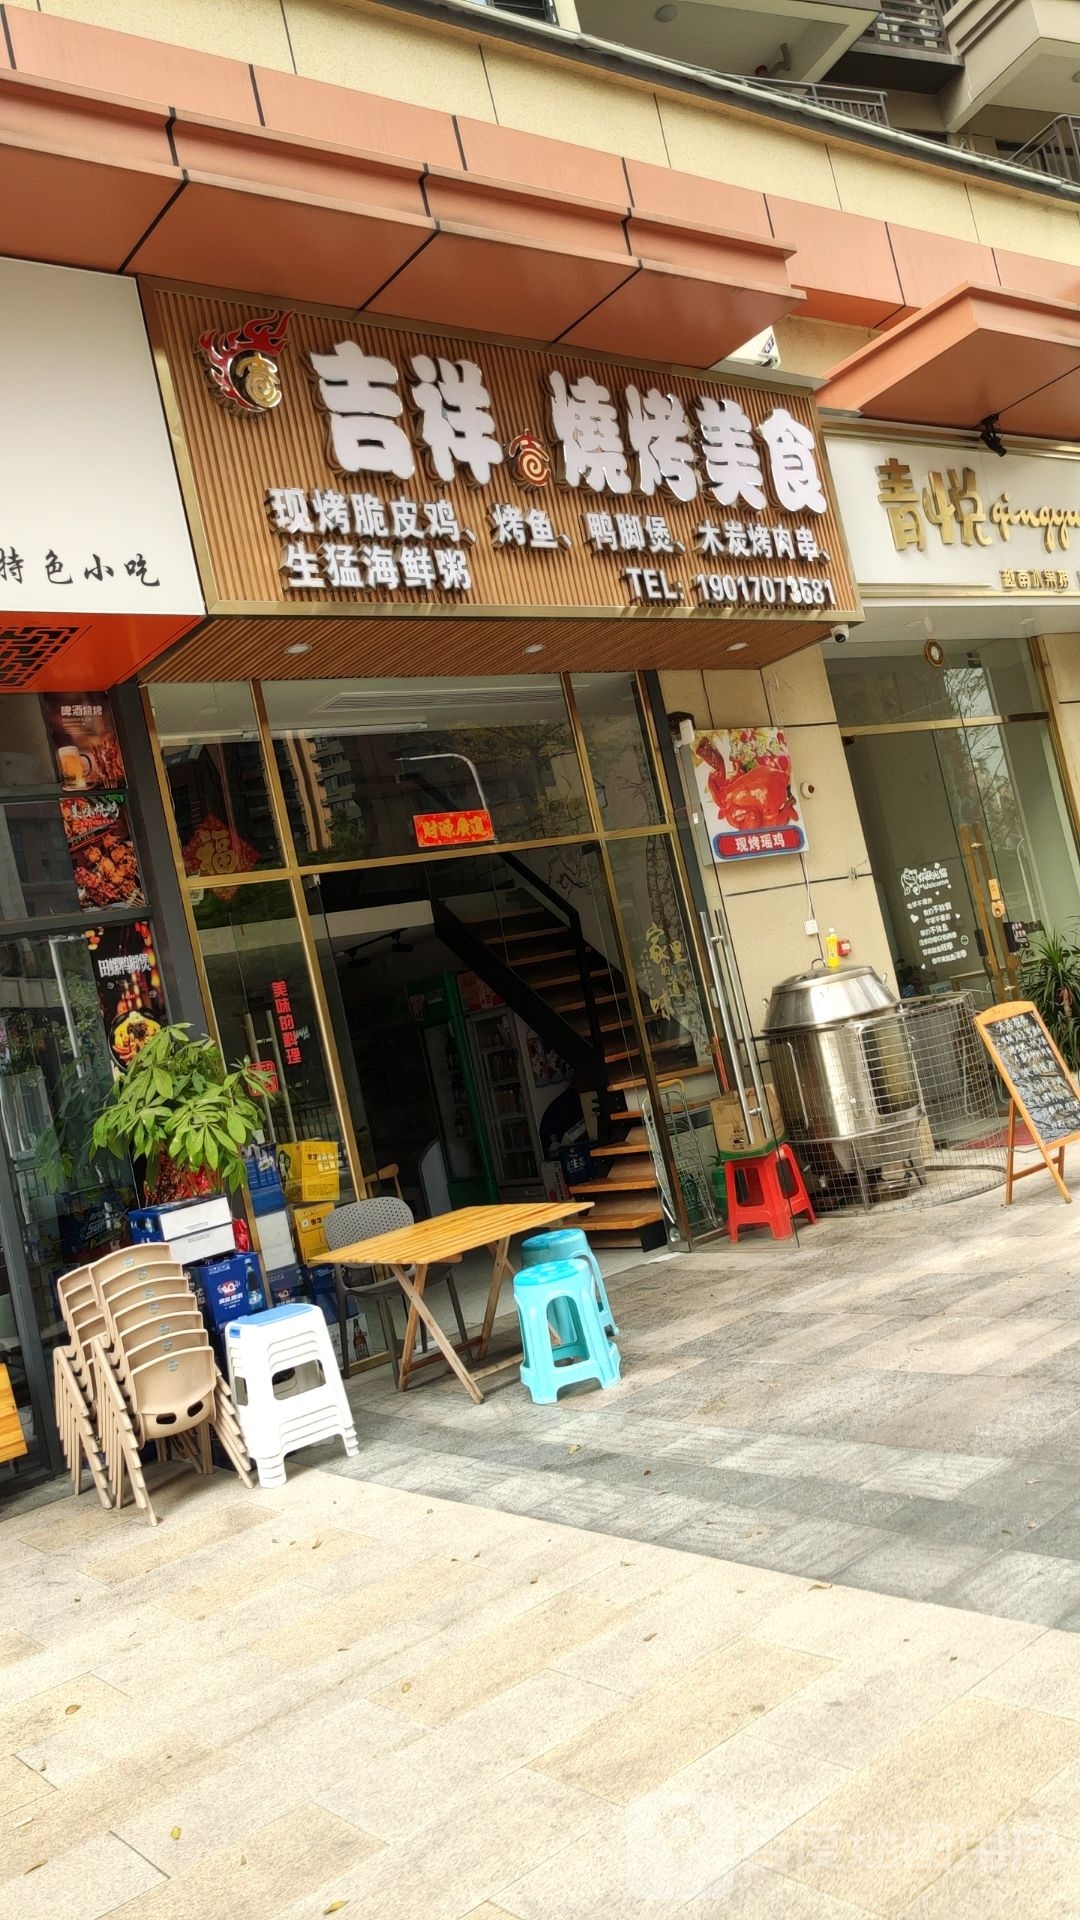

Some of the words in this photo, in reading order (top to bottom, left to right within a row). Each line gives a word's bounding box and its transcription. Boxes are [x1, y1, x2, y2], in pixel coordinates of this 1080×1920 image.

[307, 339, 503, 486] 吉祥
[548, 370, 828, 514] 燒烤美食
[268, 487, 477, 543] 现烤脆皮鸡、
[493, 503, 573, 549] 烤鱼、
[585, 512, 685, 552] 鸭脚煲、
[696, 519, 832, 562] 木炭烤肉串、
[877, 458, 992, 552] 青悦
[287, 542, 472, 590] 生猛海鲜粥
[60, 704, 103, 717] 啤酒烧烤
[71, 800, 120, 819] 美味烧烤
[196, 828, 240, 875] 福
[735, 831, 786, 853] 现烤瑶鸡
